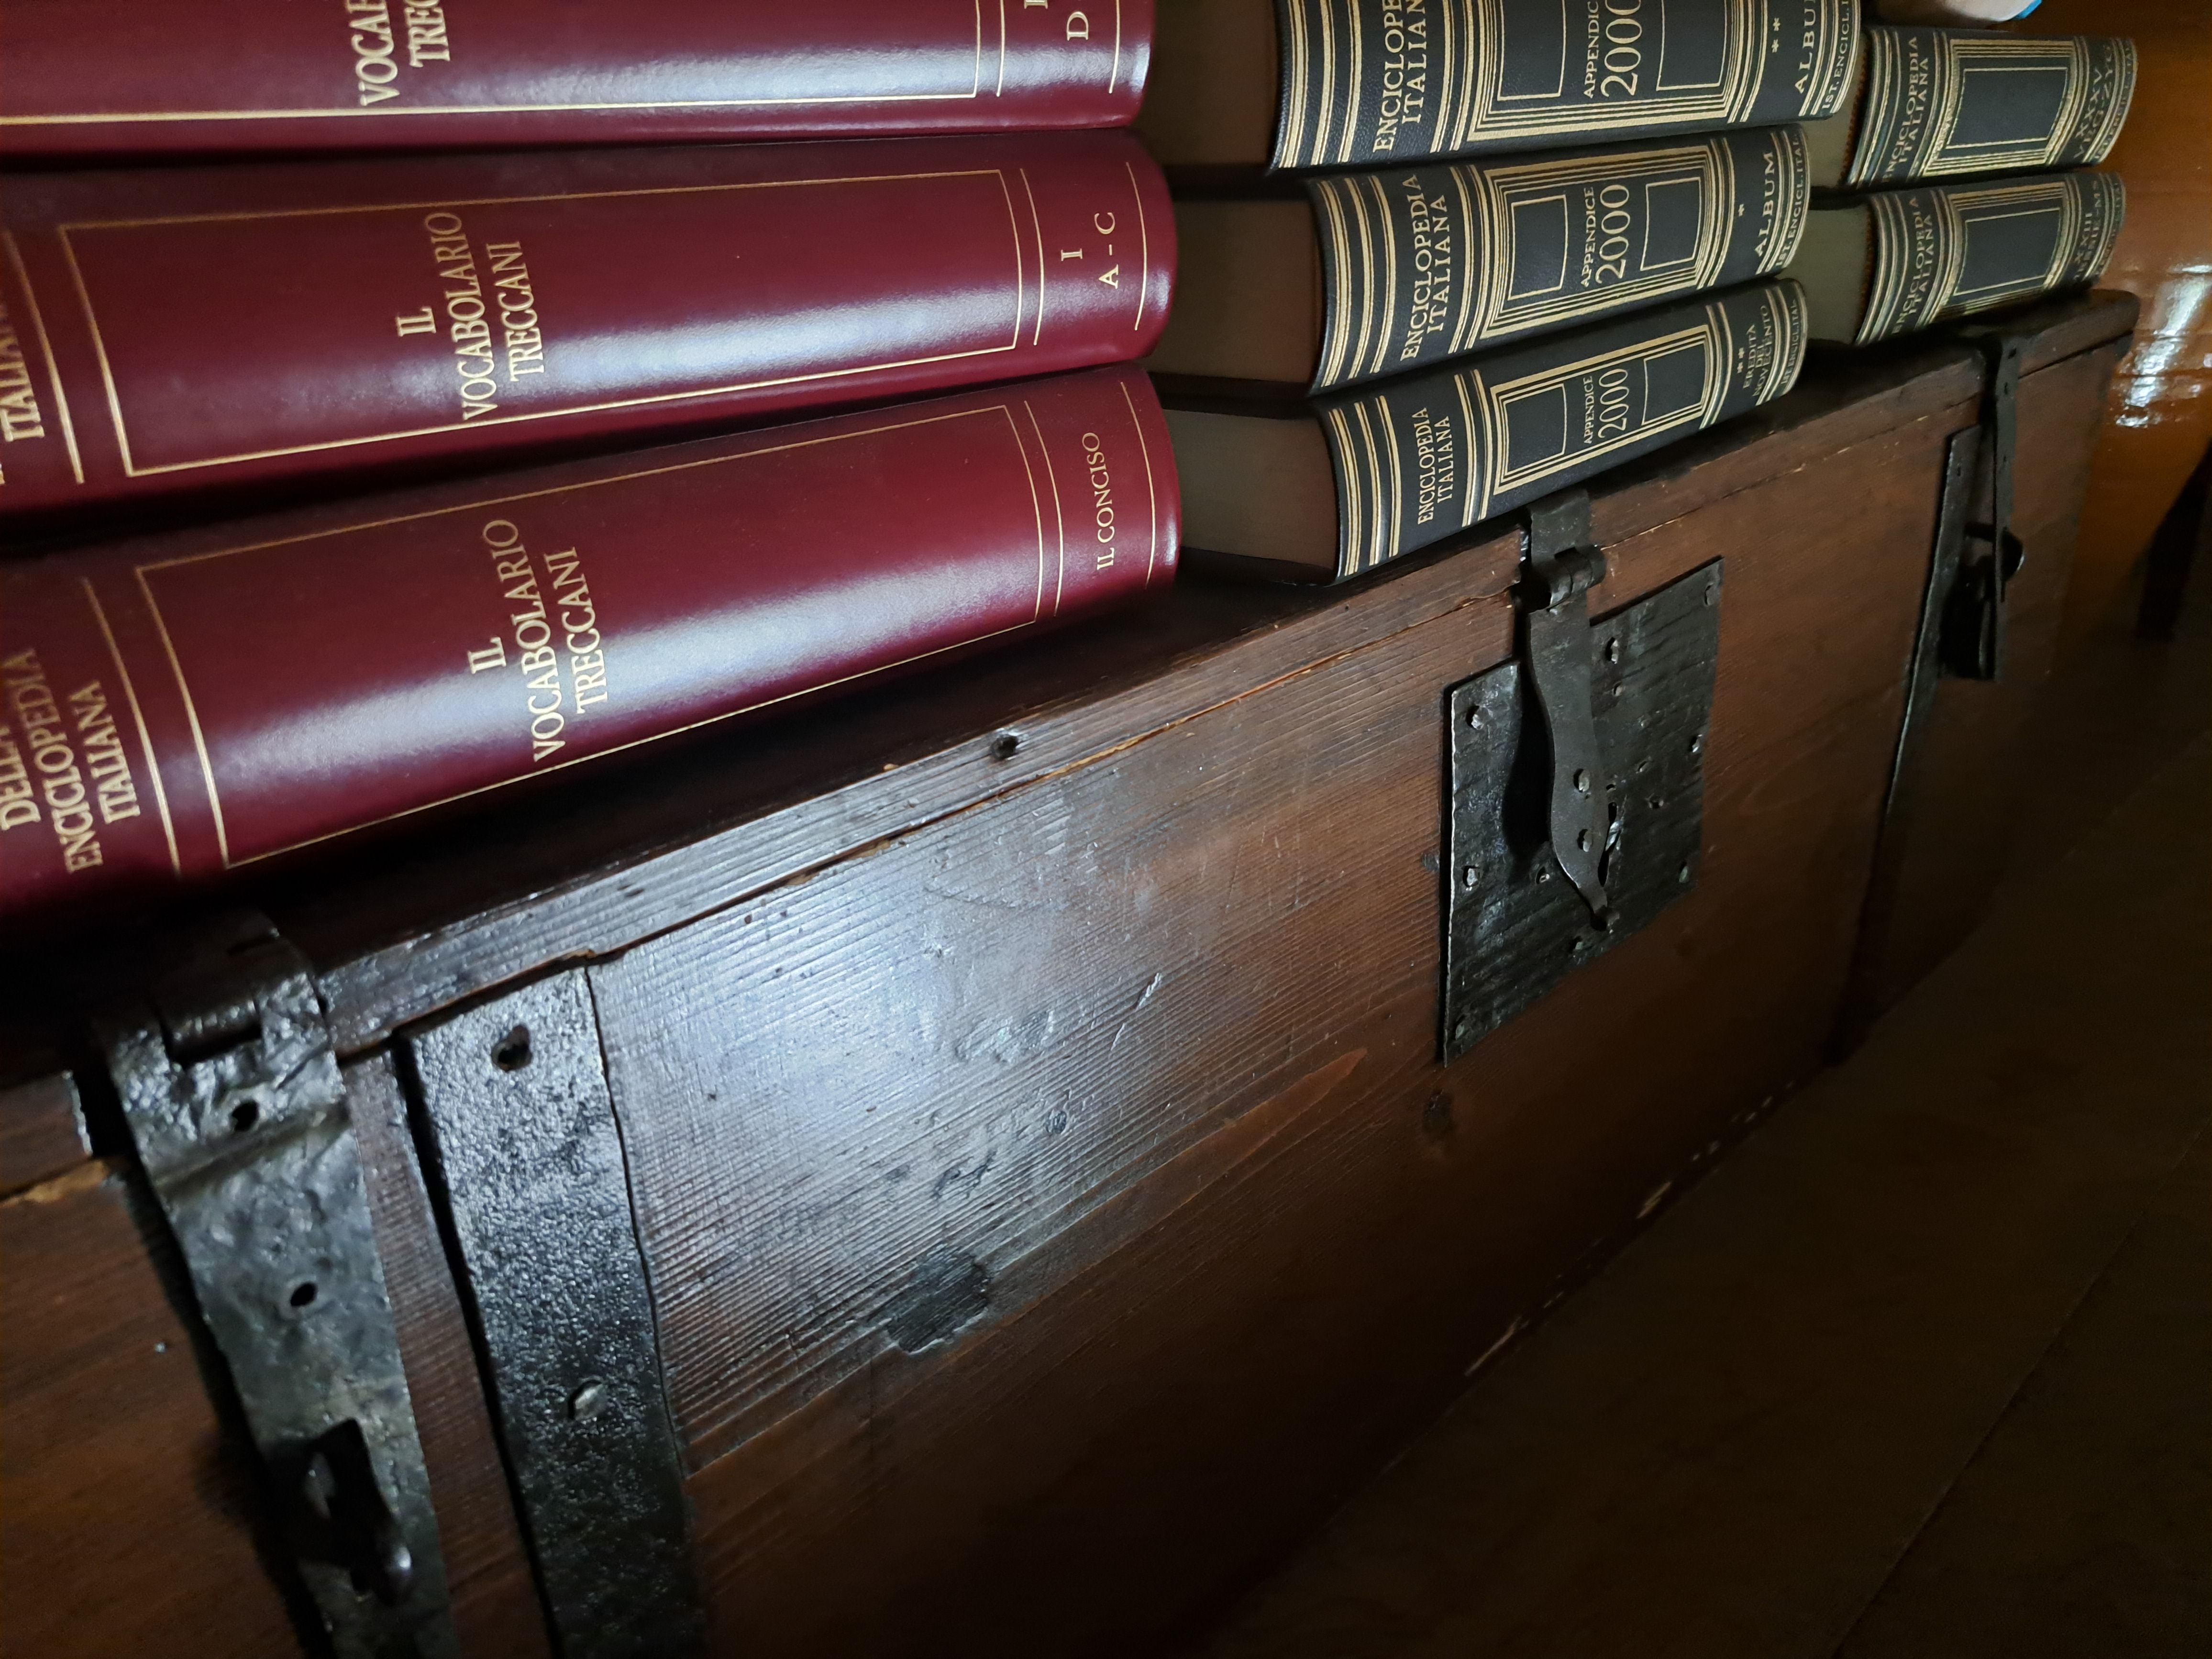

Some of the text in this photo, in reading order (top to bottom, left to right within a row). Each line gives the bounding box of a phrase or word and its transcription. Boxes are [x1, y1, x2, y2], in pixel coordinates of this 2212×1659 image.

[1066, 11, 1089, 41] D
[1600, 0, 1642, 97] 2000
[1795, 0, 1815, 94] ALBU
[1899, 58, 1929, 163] ITALIANA
[1061, 248, 1083, 261] I
[1581, 187, 1596, 287] APPENDICE
[1595, 184, 1630, 284] 2000
[1754, 152, 1775, 257] ALBUM
[486, 241, 544, 382] TRECCANI
[1400, 174, 1432, 361] ENCICLOPEDIA
[1427, 195, 1450, 334] ITALIANA
[1891, 196, 1925, 334] ENCICLOPEDIA
[1909, 214, 1935, 314] ITALIANA
[396, 304, 437, 337] IL
[425, 212, 498, 420] VOCABOLARIO
[1752, 305, 1772, 397] NOVECENTO
[1582, 376, 1595, 444] APPENDICE
[1597, 368, 1630, 438] 2000
[1082, 432, 1115, 570] IL CONCISO
[1412, 407, 1435, 525] ENCICLOPEDIA
[1434, 416, 1454, 504] ITALIANA
[467, 637, 507, 675] IL
[482, 520, 566, 762] VOCABOLARIO
[544, 546, 608, 714] TRECCANI
[2, 648, 103, 874] ENCICLOPEDIA
[68, 680, 141, 824] ITALIANA
